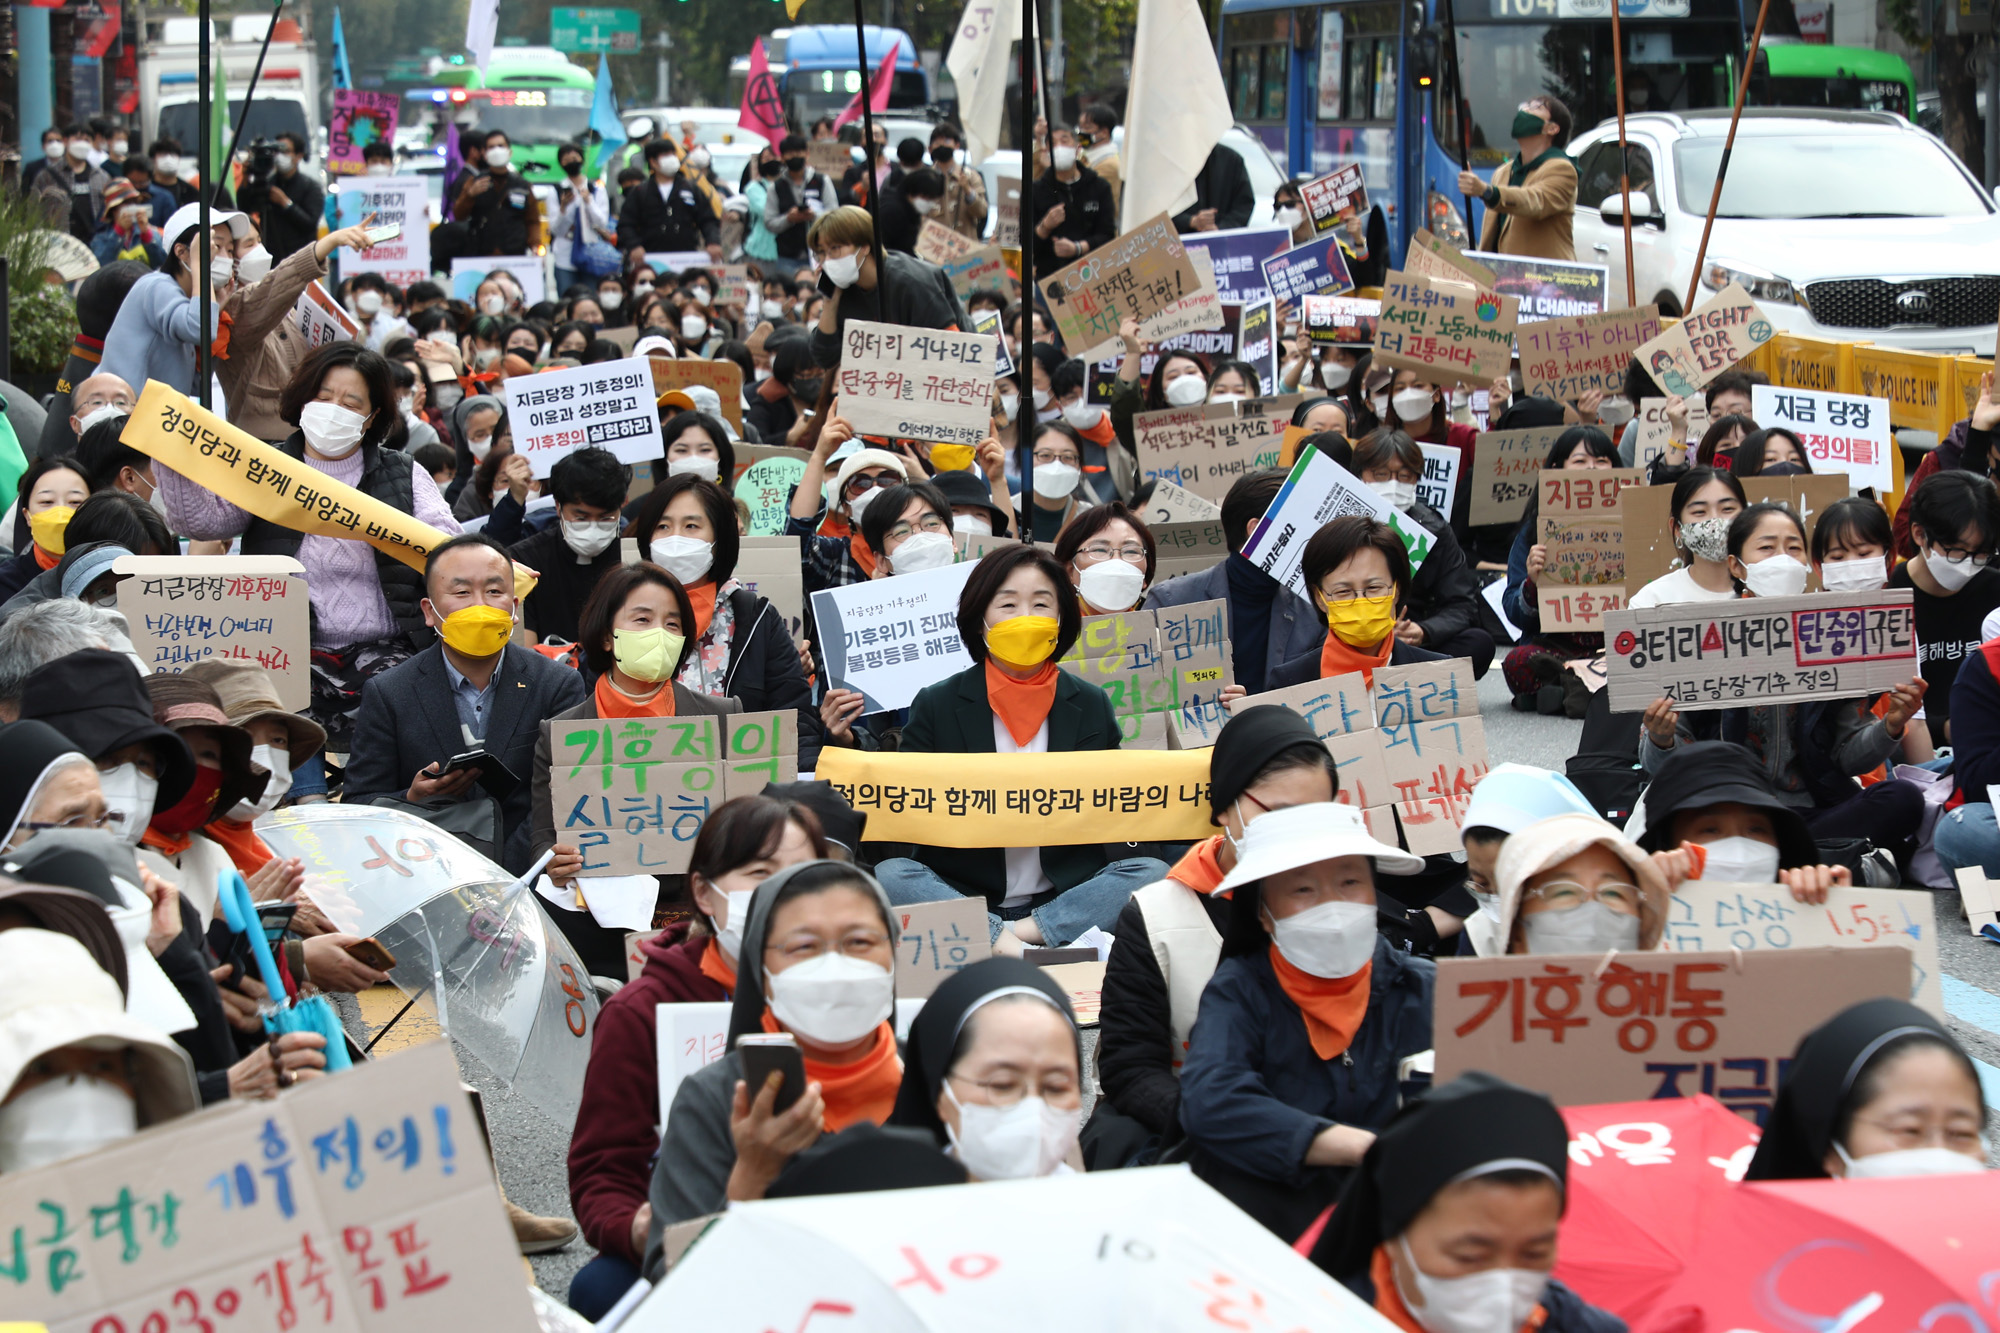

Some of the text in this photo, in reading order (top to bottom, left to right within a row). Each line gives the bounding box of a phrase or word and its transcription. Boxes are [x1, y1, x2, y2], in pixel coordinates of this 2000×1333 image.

[1390, 283, 1455, 308] 기후위기
[1903, 296, 1928, 310] KIA
[1683, 305, 1754, 338] FIGHT
[1380, 331, 1403, 354] 더
[1404, 335, 1477, 366] 고통이다
[1529, 325, 1595, 358] 기후가
[1689, 330, 1733, 356] FOR
[516, 373, 645, 408] 지금당장 기후정의!
[1792, 359, 1837, 393] POLICE LIN
[1880, 373, 1940, 408] POLICE LIN
[530, 396, 638, 427] 이윤과 성장말고
[1774, 393, 1872, 430] 지금 당장
[526, 417, 650, 452] 기후정의 실현하라
[1218, 420, 1270, 447] 발전소
[161, 404, 243, 470] 정의당과
[247, 456, 293, 498] 함께
[294, 484, 362, 532] 태양과
[1545, 476, 1641, 511] 지금당
[1159, 525, 1224, 549] 지금 당
[887, 592, 929, 611] 기후정의!
[844, 618, 915, 650] 기후위기
[1163, 606, 1225, 662] 함께
[847, 642, 921, 674] 불평등을
[1191, 670, 1218, 682] 정의당
[564, 715, 781, 795] 기후정의
[944, 785, 998, 817] 함께
[1005, 785, 1086, 817] 태양과
[1092, 784, 1170, 814] 바람의
